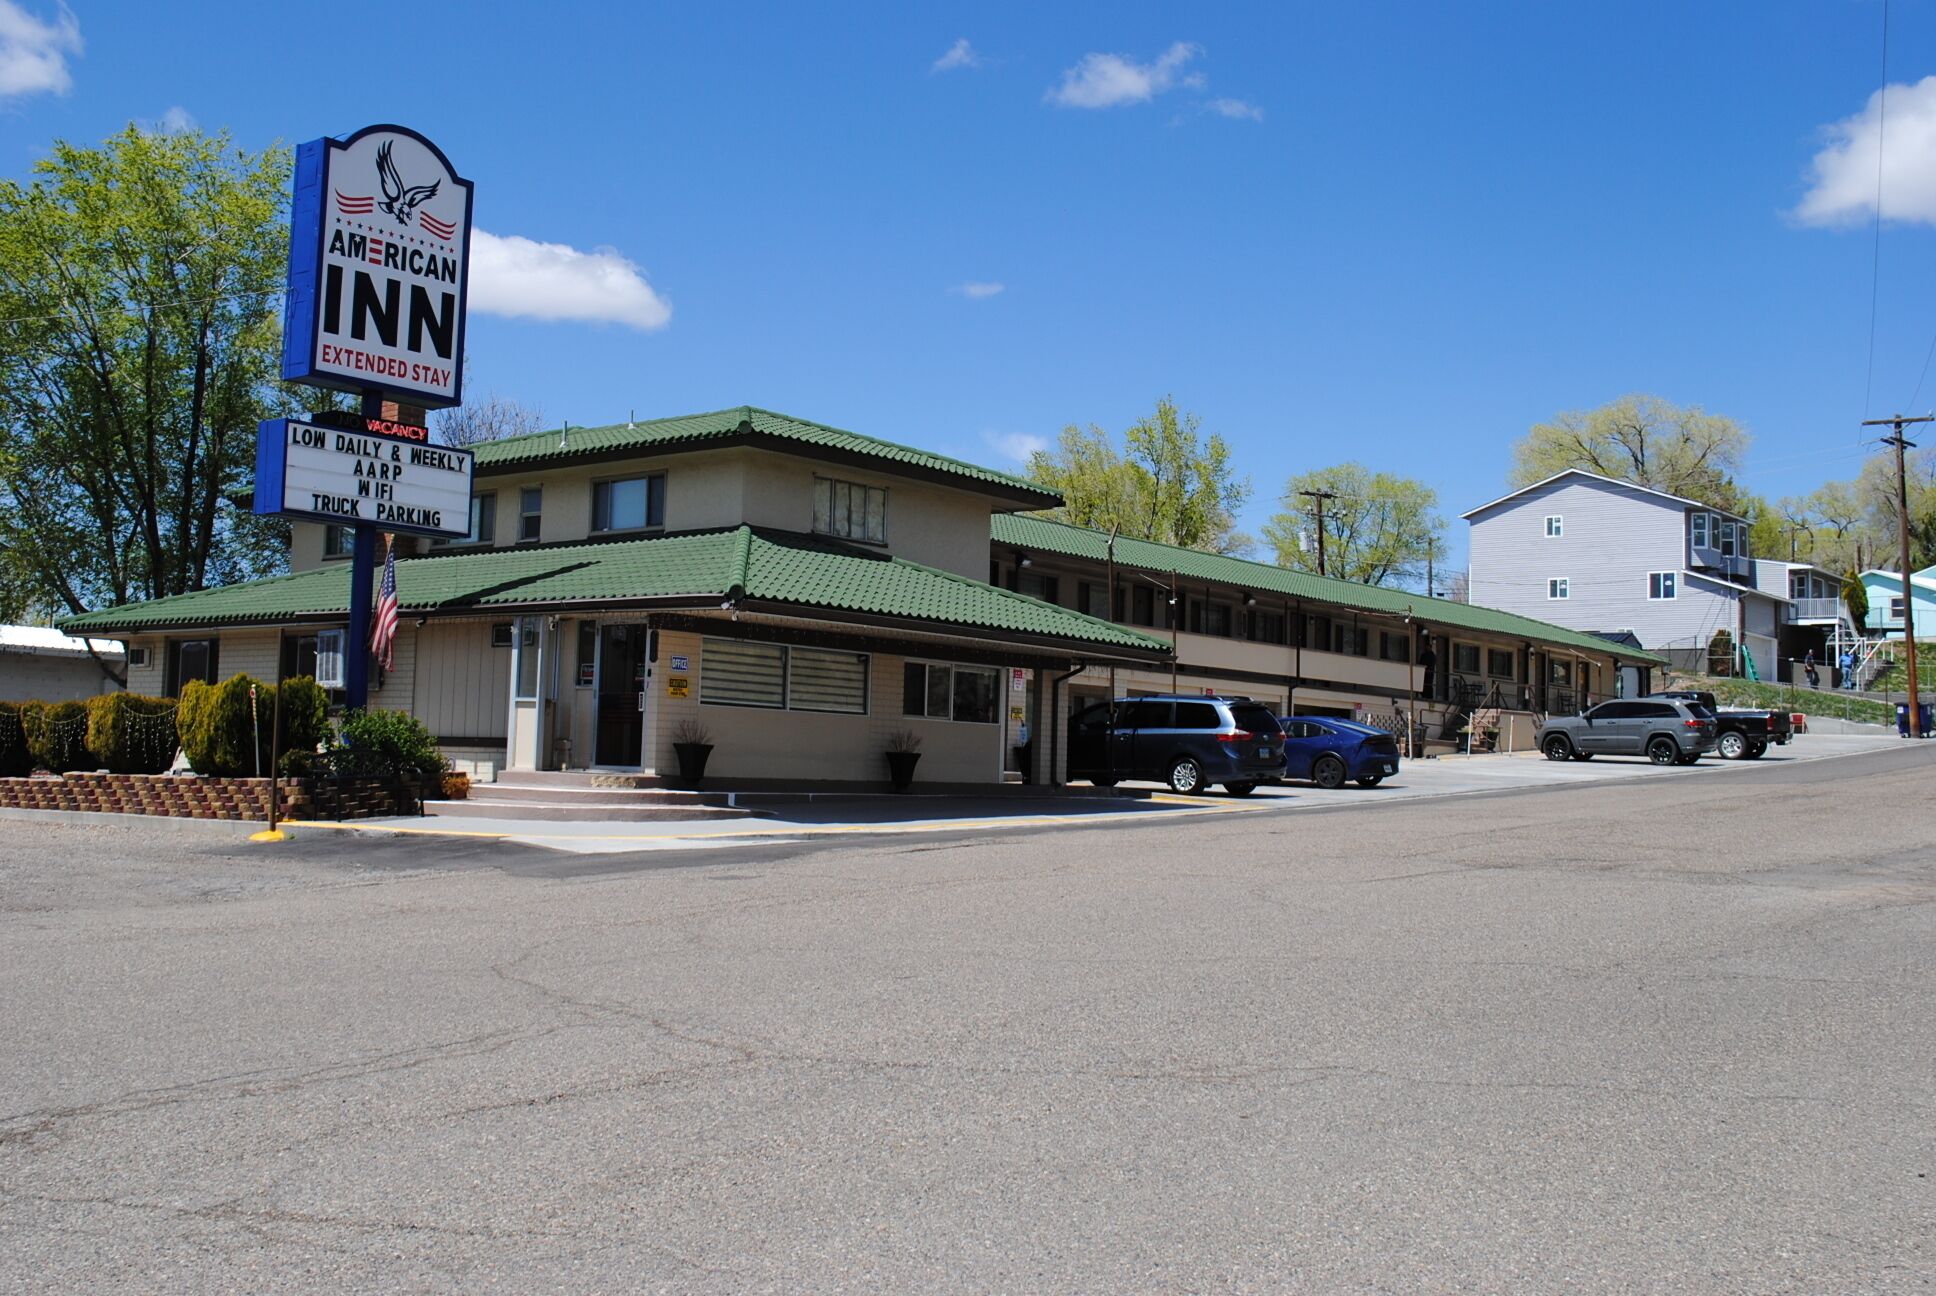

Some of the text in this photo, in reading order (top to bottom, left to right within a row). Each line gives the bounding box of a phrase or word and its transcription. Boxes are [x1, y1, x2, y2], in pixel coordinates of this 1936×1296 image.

[328, 229, 457, 284] AMERICAN
[323, 263, 456, 360] INN
[321, 344, 451, 388] EXTENDED STAY
[292, 426, 466, 472] LOW DAILY & WEEKLY
[366, 418, 427, 441] VACANCY
[353, 459, 403, 481] AARP
[312, 493, 441, 527] TRUCK PARKING
[672, 658, 688, 669] OFFICE
